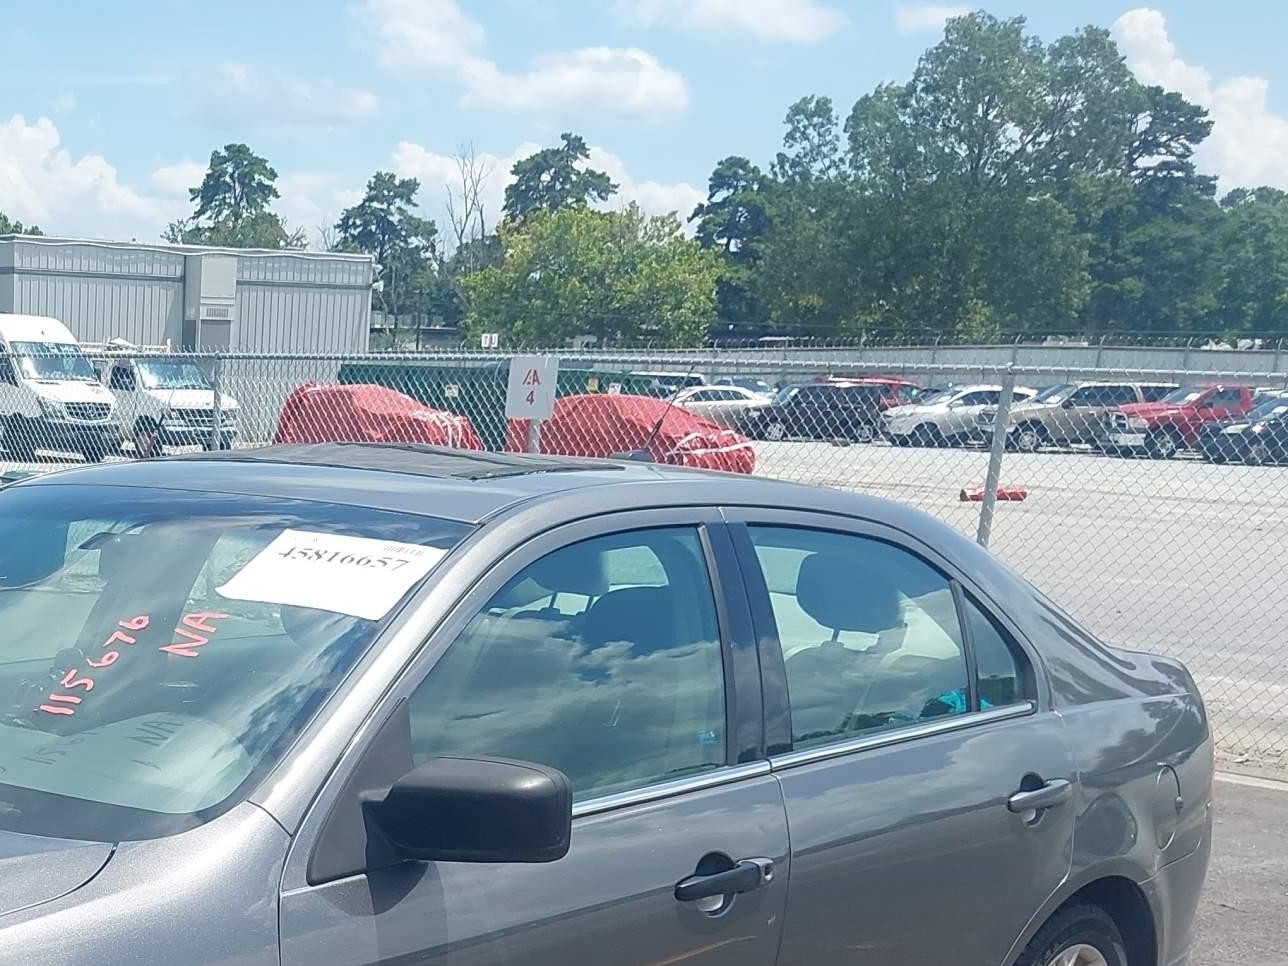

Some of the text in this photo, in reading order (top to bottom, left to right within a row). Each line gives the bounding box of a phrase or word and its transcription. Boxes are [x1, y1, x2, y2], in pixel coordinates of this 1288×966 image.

[526, 390, 535, 405] 4
[278, 546, 411, 571] 45816657
[158, 612, 229, 657] NA
